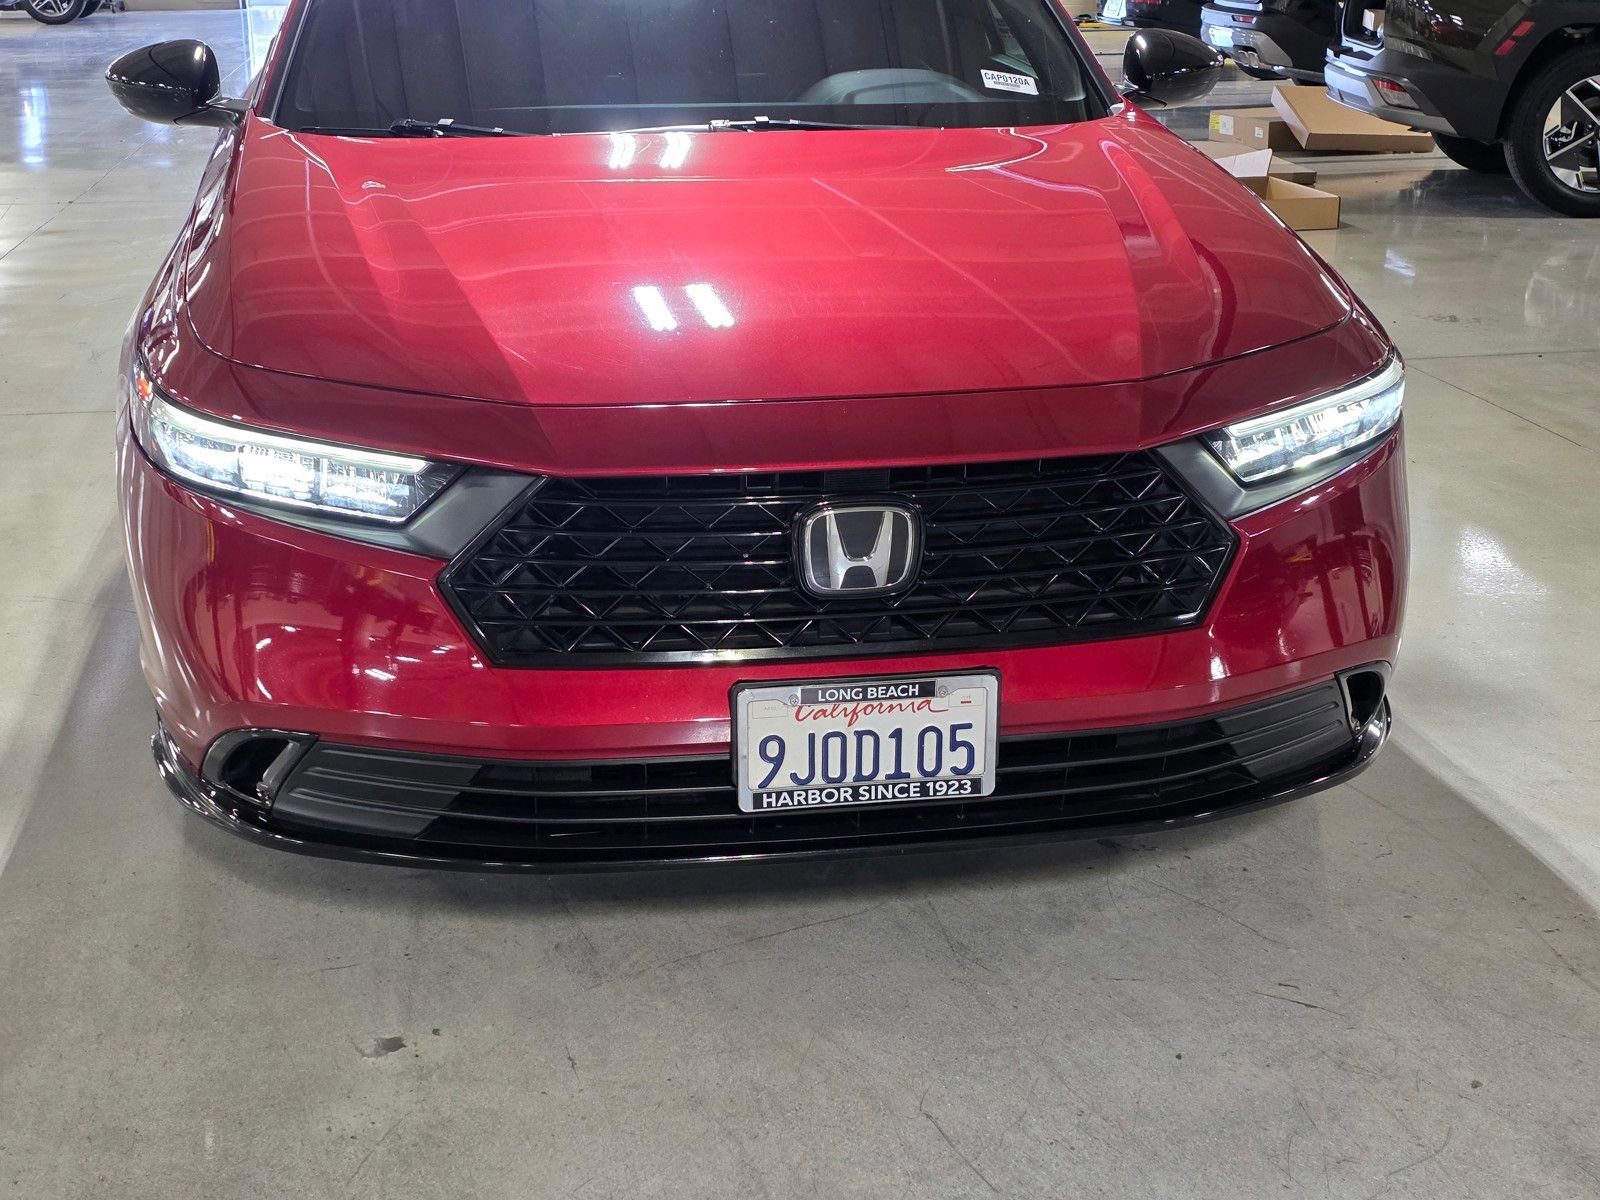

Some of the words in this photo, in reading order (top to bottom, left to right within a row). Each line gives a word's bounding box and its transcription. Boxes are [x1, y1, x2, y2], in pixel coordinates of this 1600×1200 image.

[818, 688, 863, 701] LONG
[867, 684, 919, 698] BEACH
[795, 699, 948, 727] California
[762, 787, 853, 808] HARBOR
[858, 782, 921, 801] SINCE
[926, 779, 972, 797] 1923
